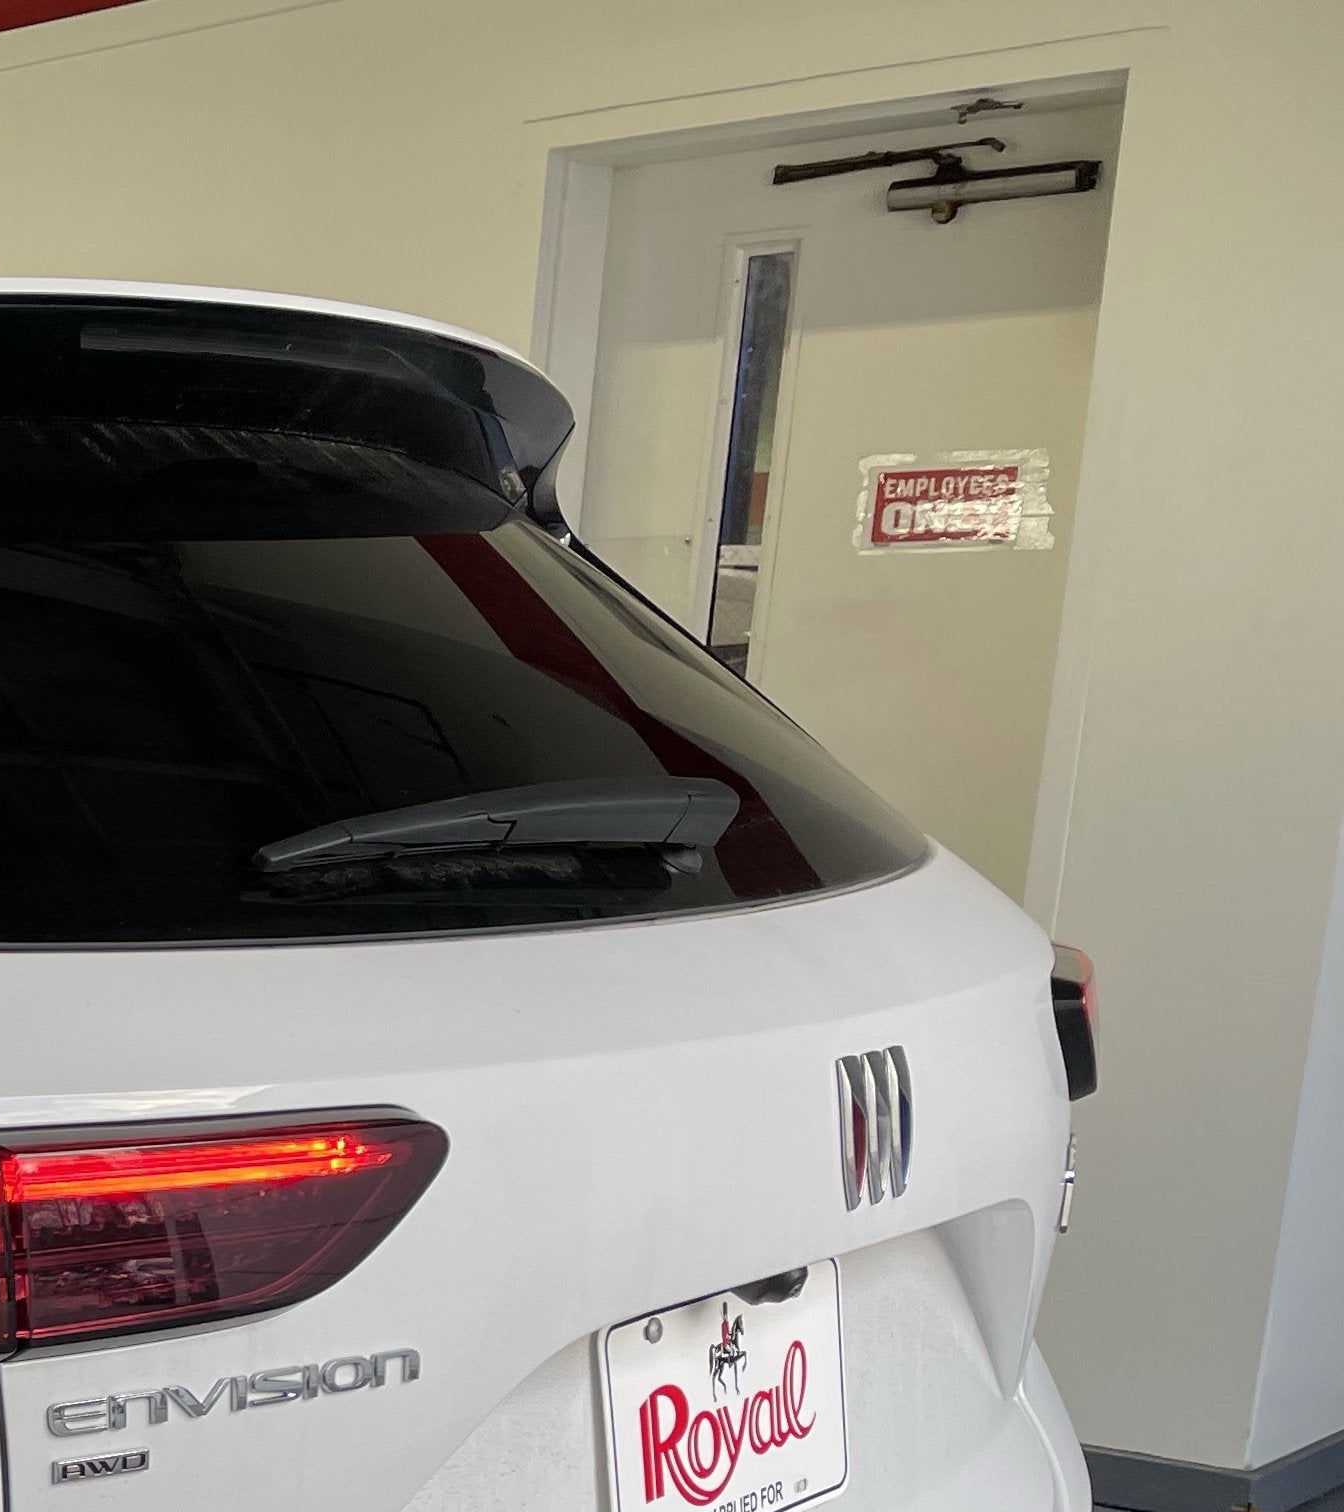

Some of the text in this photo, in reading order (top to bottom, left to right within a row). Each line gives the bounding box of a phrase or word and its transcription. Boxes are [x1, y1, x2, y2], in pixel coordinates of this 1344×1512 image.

[884, 473, 1010, 500] EMPLOYEES
[881, 500, 1012, 537] ON
[639, 1339, 817, 1507] Royal
[60, 1451, 147, 1481] AWD
[759, 1480, 784, 1509] FOR
